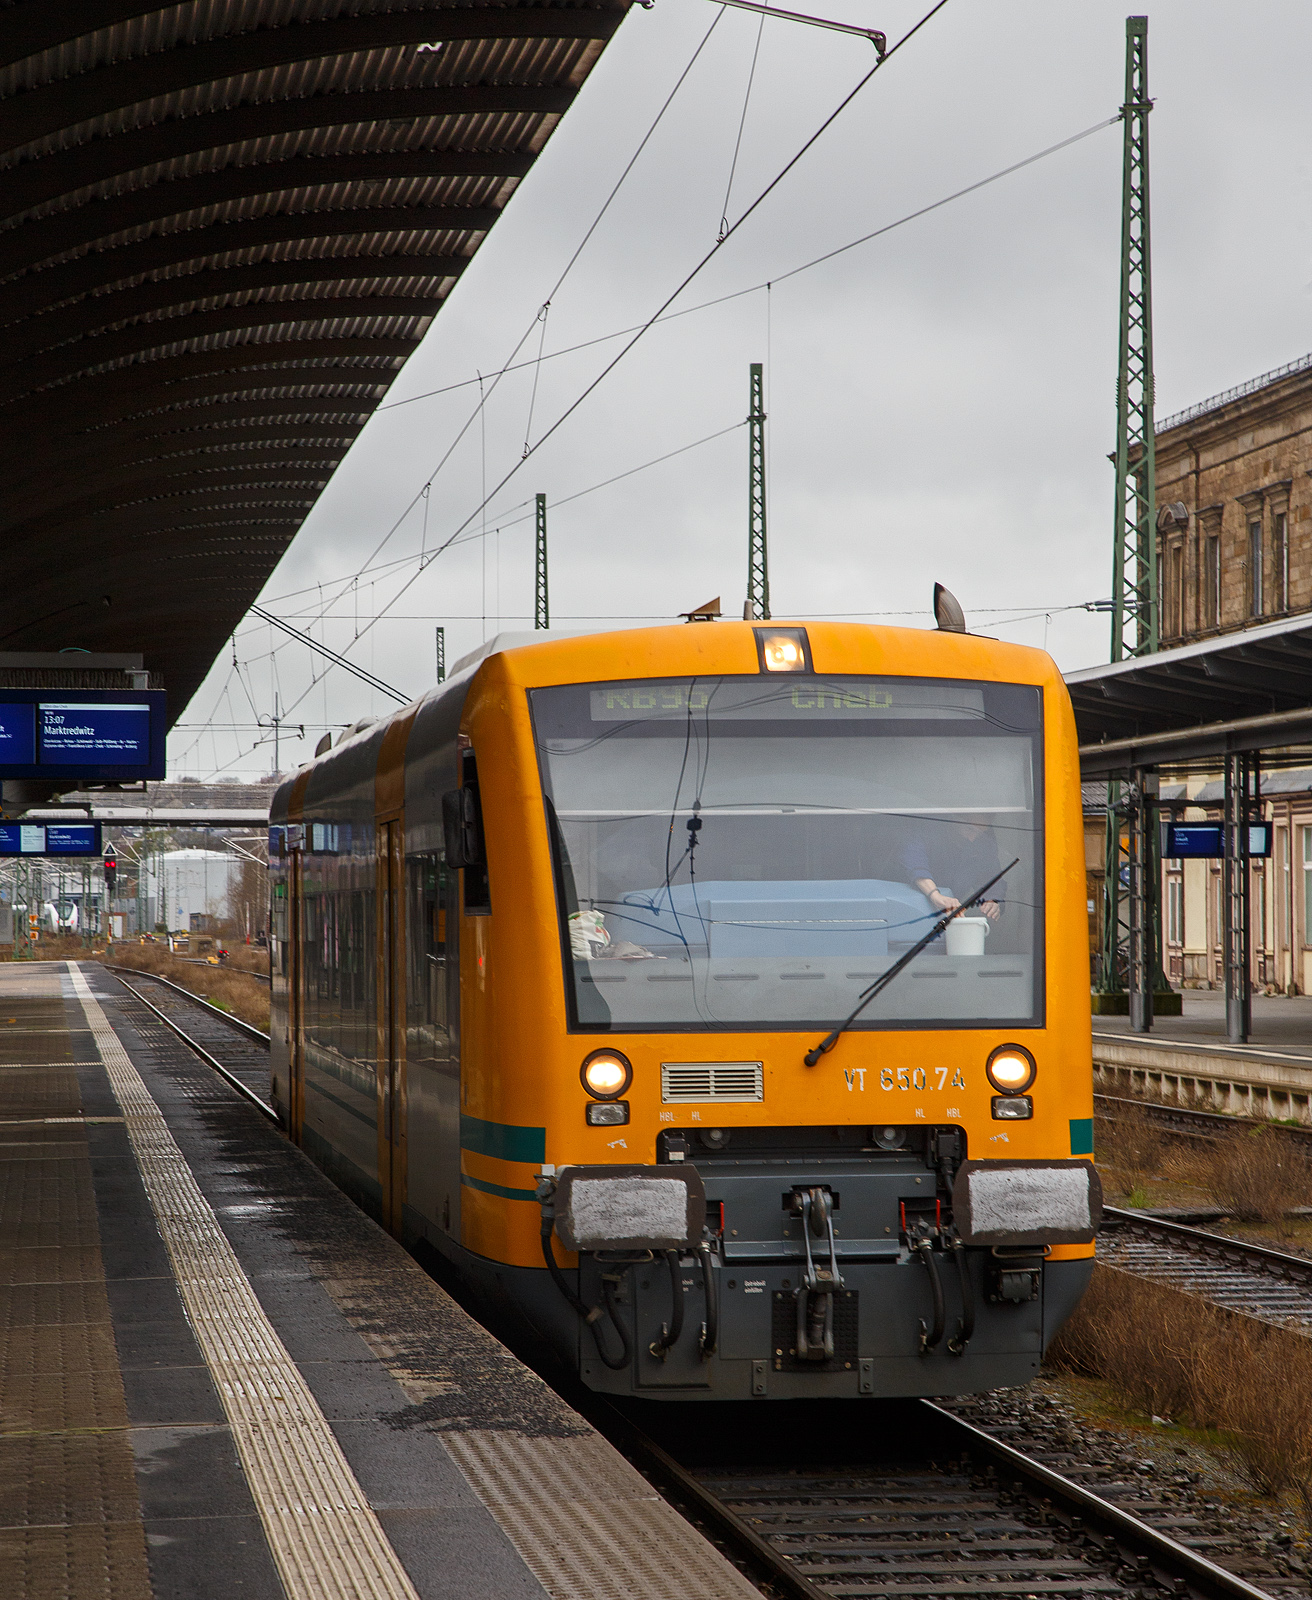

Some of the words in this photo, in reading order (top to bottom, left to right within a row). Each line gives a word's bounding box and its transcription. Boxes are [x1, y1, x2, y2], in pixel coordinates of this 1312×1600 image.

[792, 685, 893, 709] Cheb
[44, 715, 65, 724] 13:07
[43, 726, 95, 735] Marktredwitz
[844, 1068, 867, 1091] VT
[880, 1067, 966, 1091] 650.74
[659, 1112, 675, 1122] HBL
[691, 1111, 702, 1121] HL
[915, 1108, 926, 1118] HL
[946, 1108, 962, 1118] HBL
